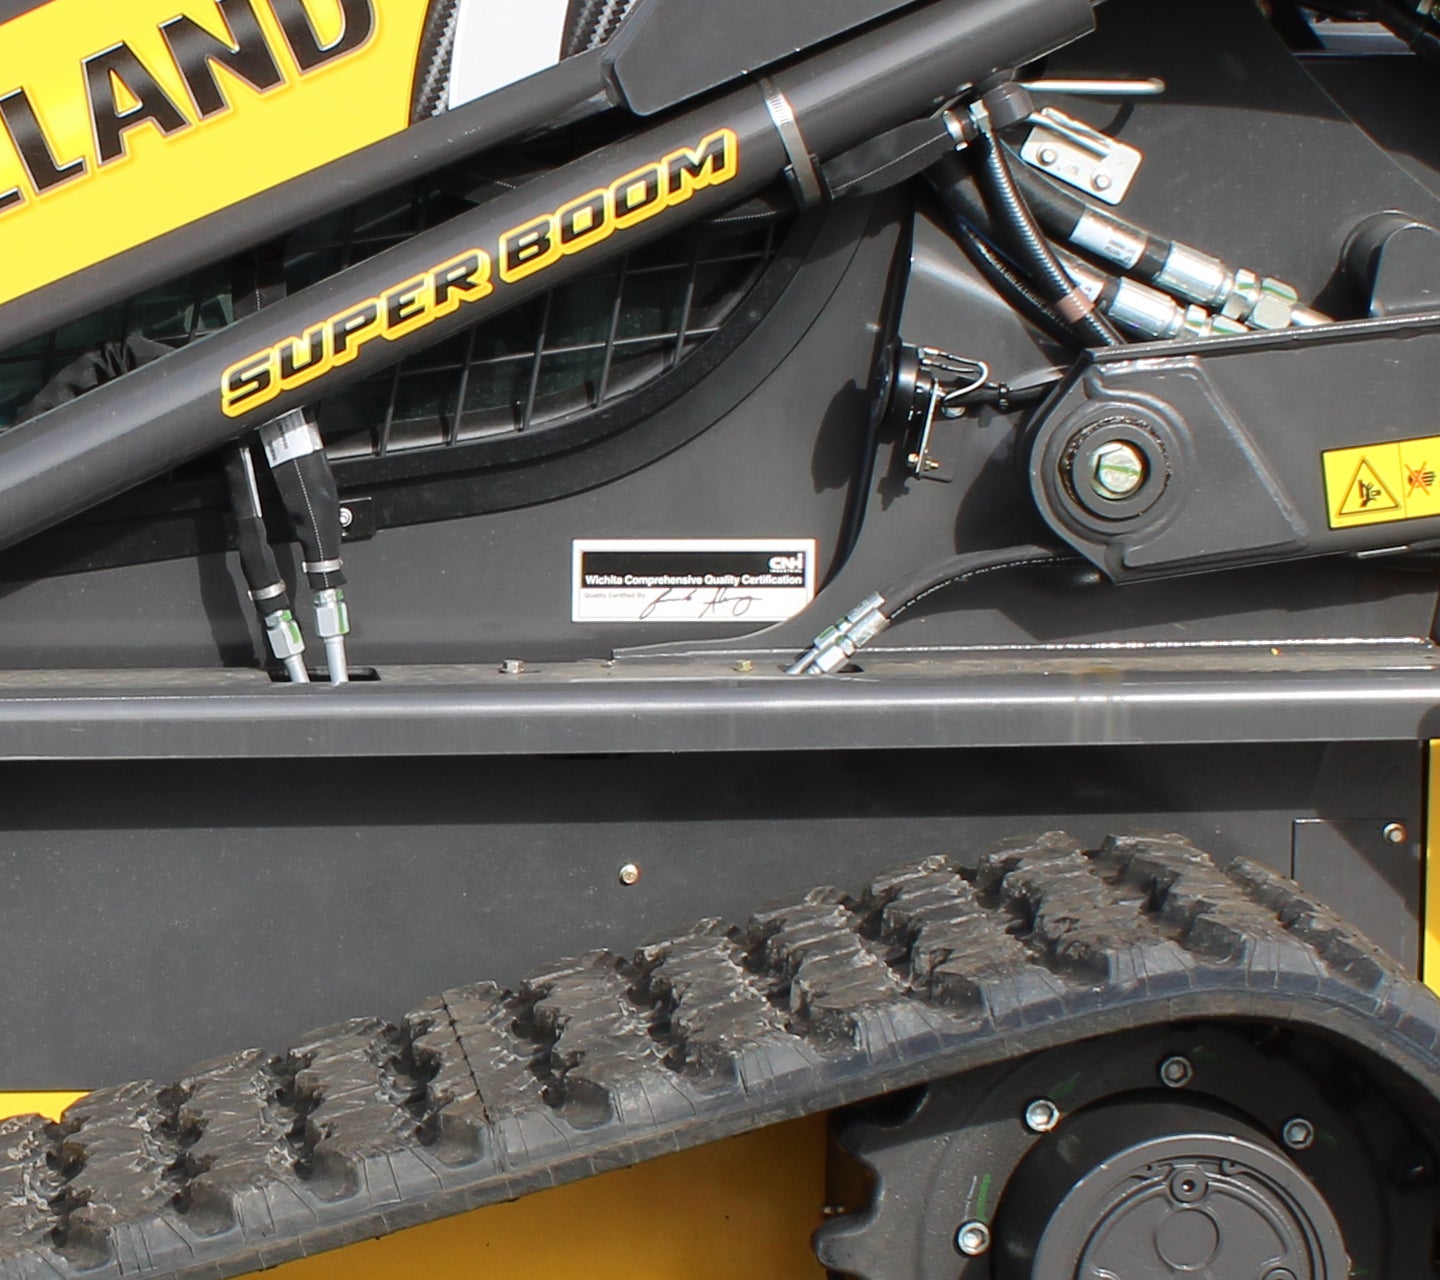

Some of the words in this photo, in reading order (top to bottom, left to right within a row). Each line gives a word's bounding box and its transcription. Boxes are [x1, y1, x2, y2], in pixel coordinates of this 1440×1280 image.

[222, 246, 492, 417] SUPER
[498, 126, 741, 278] BOOM
[585, 574, 623, 586] Wichita
[624, 574, 703, 587] Comprehensive
[704, 574, 740, 587] Quality
[742, 574, 803, 586] Certification
[584, 592, 607, 600] Quality
